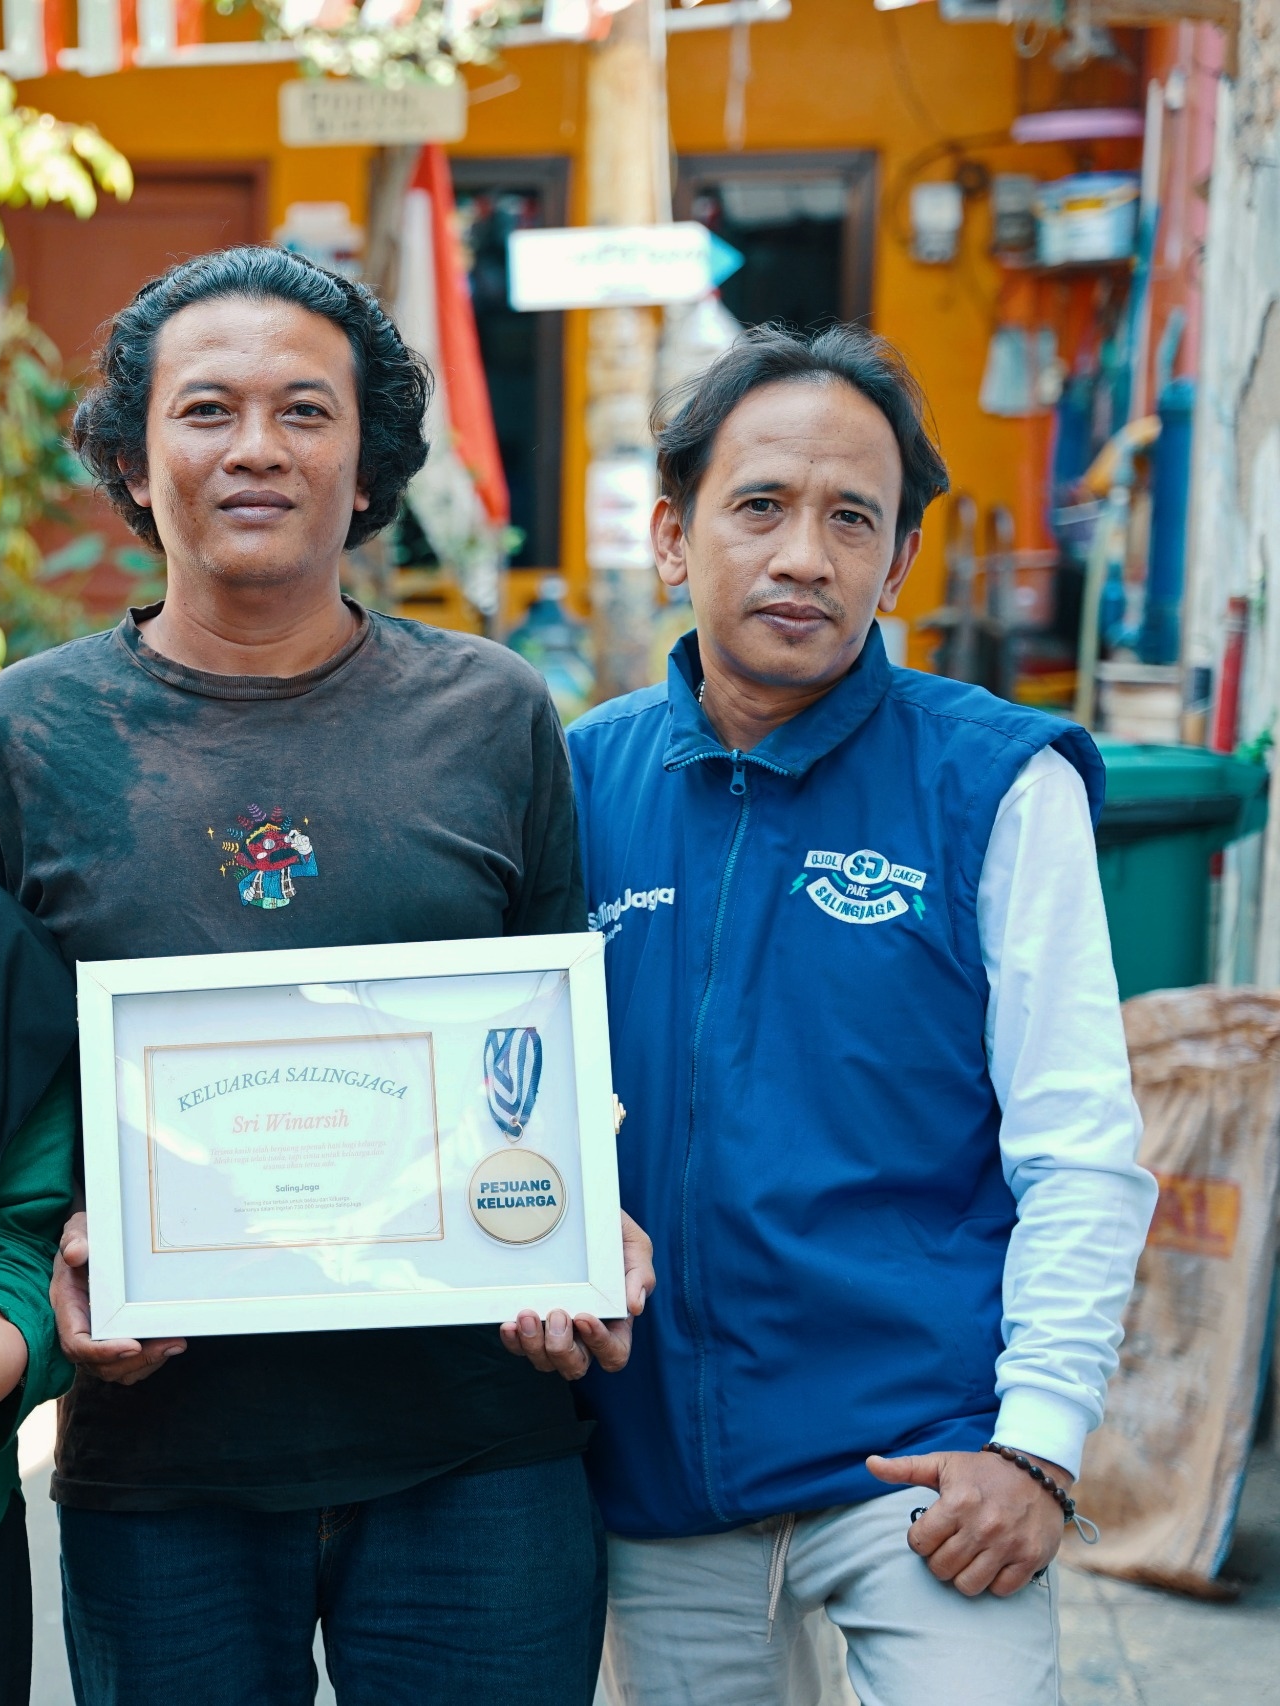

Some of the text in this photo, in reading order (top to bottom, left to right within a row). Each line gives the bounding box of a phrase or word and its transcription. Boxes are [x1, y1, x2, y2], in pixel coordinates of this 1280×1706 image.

[811, 854, 838, 867] OJOL
[849, 854, 884, 879] SJ
[892, 868, 922, 884] CAKEP
[845, 883, 871, 900] PAKE
[814, 886, 897, 920] SALINGJAGA
[177, 1066, 409, 1112] KELUARGA SALINGJAGA
[231, 1108, 350, 1134] Sri Winarsih
[275, 1183, 320, 1193] SalingJaga
[480, 1179, 551, 1194] PEJUANG
[477, 1195, 557, 1210] KELUARGA
